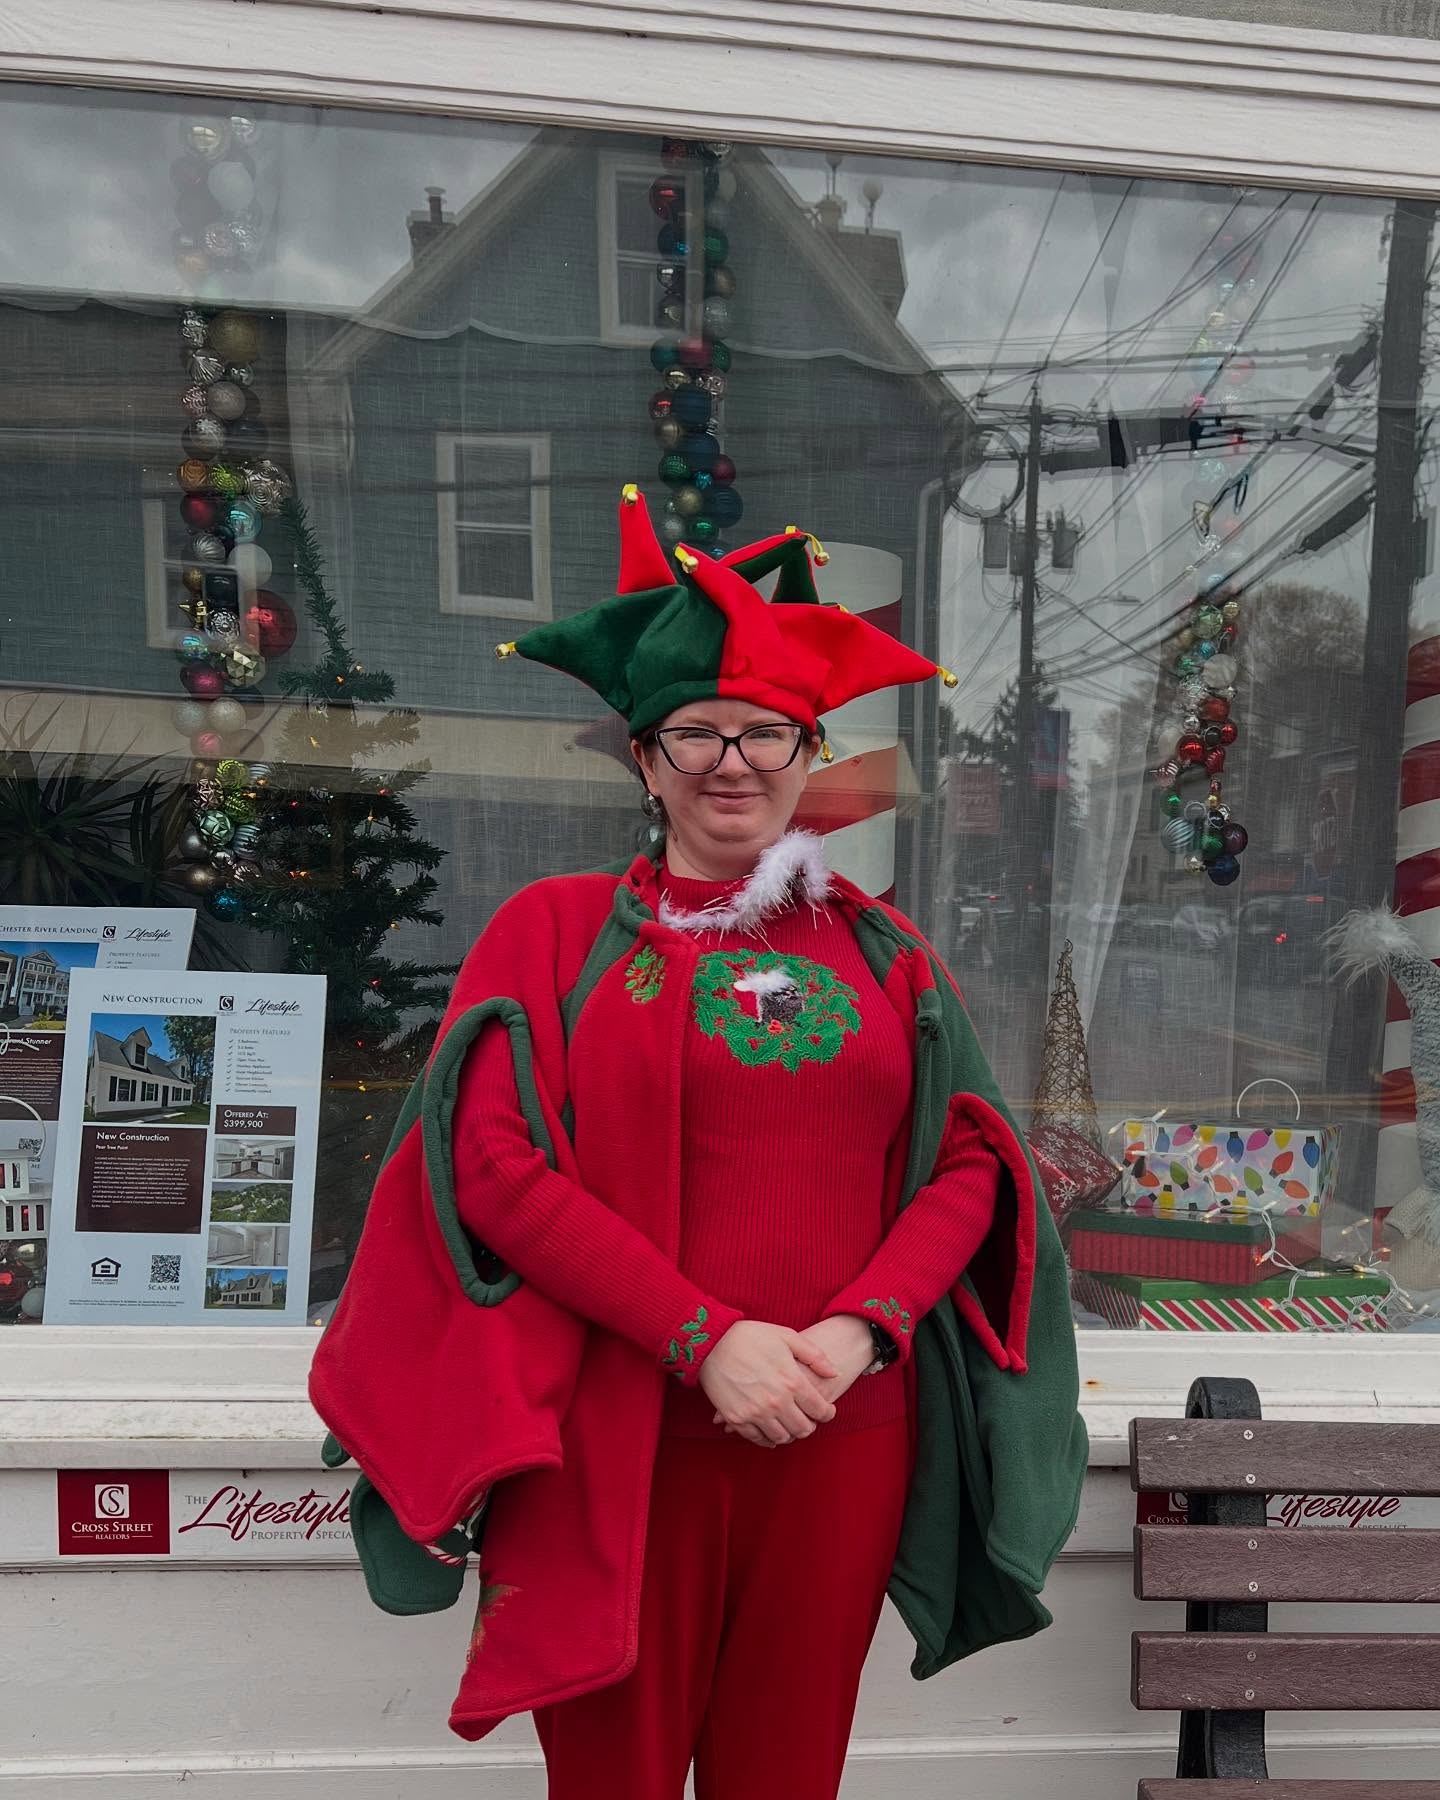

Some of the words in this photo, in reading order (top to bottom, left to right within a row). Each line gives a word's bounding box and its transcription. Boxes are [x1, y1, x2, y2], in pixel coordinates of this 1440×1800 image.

[60, 926, 98, 934] LANDING
[124, 928, 171, 941] Lifestyle
[103, 994, 125, 1003] NEW
[127, 995, 203, 1005] CONSTRUCTION
[245, 998, 300, 1016] Lifestyle
[26, 1037, 52, 1045] Stunner
[224, 1109, 255, 1118] OFFERED
[223, 1119, 264, 1129] $399,900
[96, 1131, 117, 1140] New
[119, 1132, 170, 1142] Construction
[185, 1495, 208, 1505] THE
[177, 1485, 352, 1541] Lifestyle
[1266, 1495, 1401, 1528] ifestyle
[1147, 1514, 1180, 1525] CROSS
[71, 1521, 110, 1533] CROSS
[112, 1521, 154, 1532] STREET
[251, 1531, 306, 1540] PROPERTY
[315, 1530, 353, 1540] SPECIA
